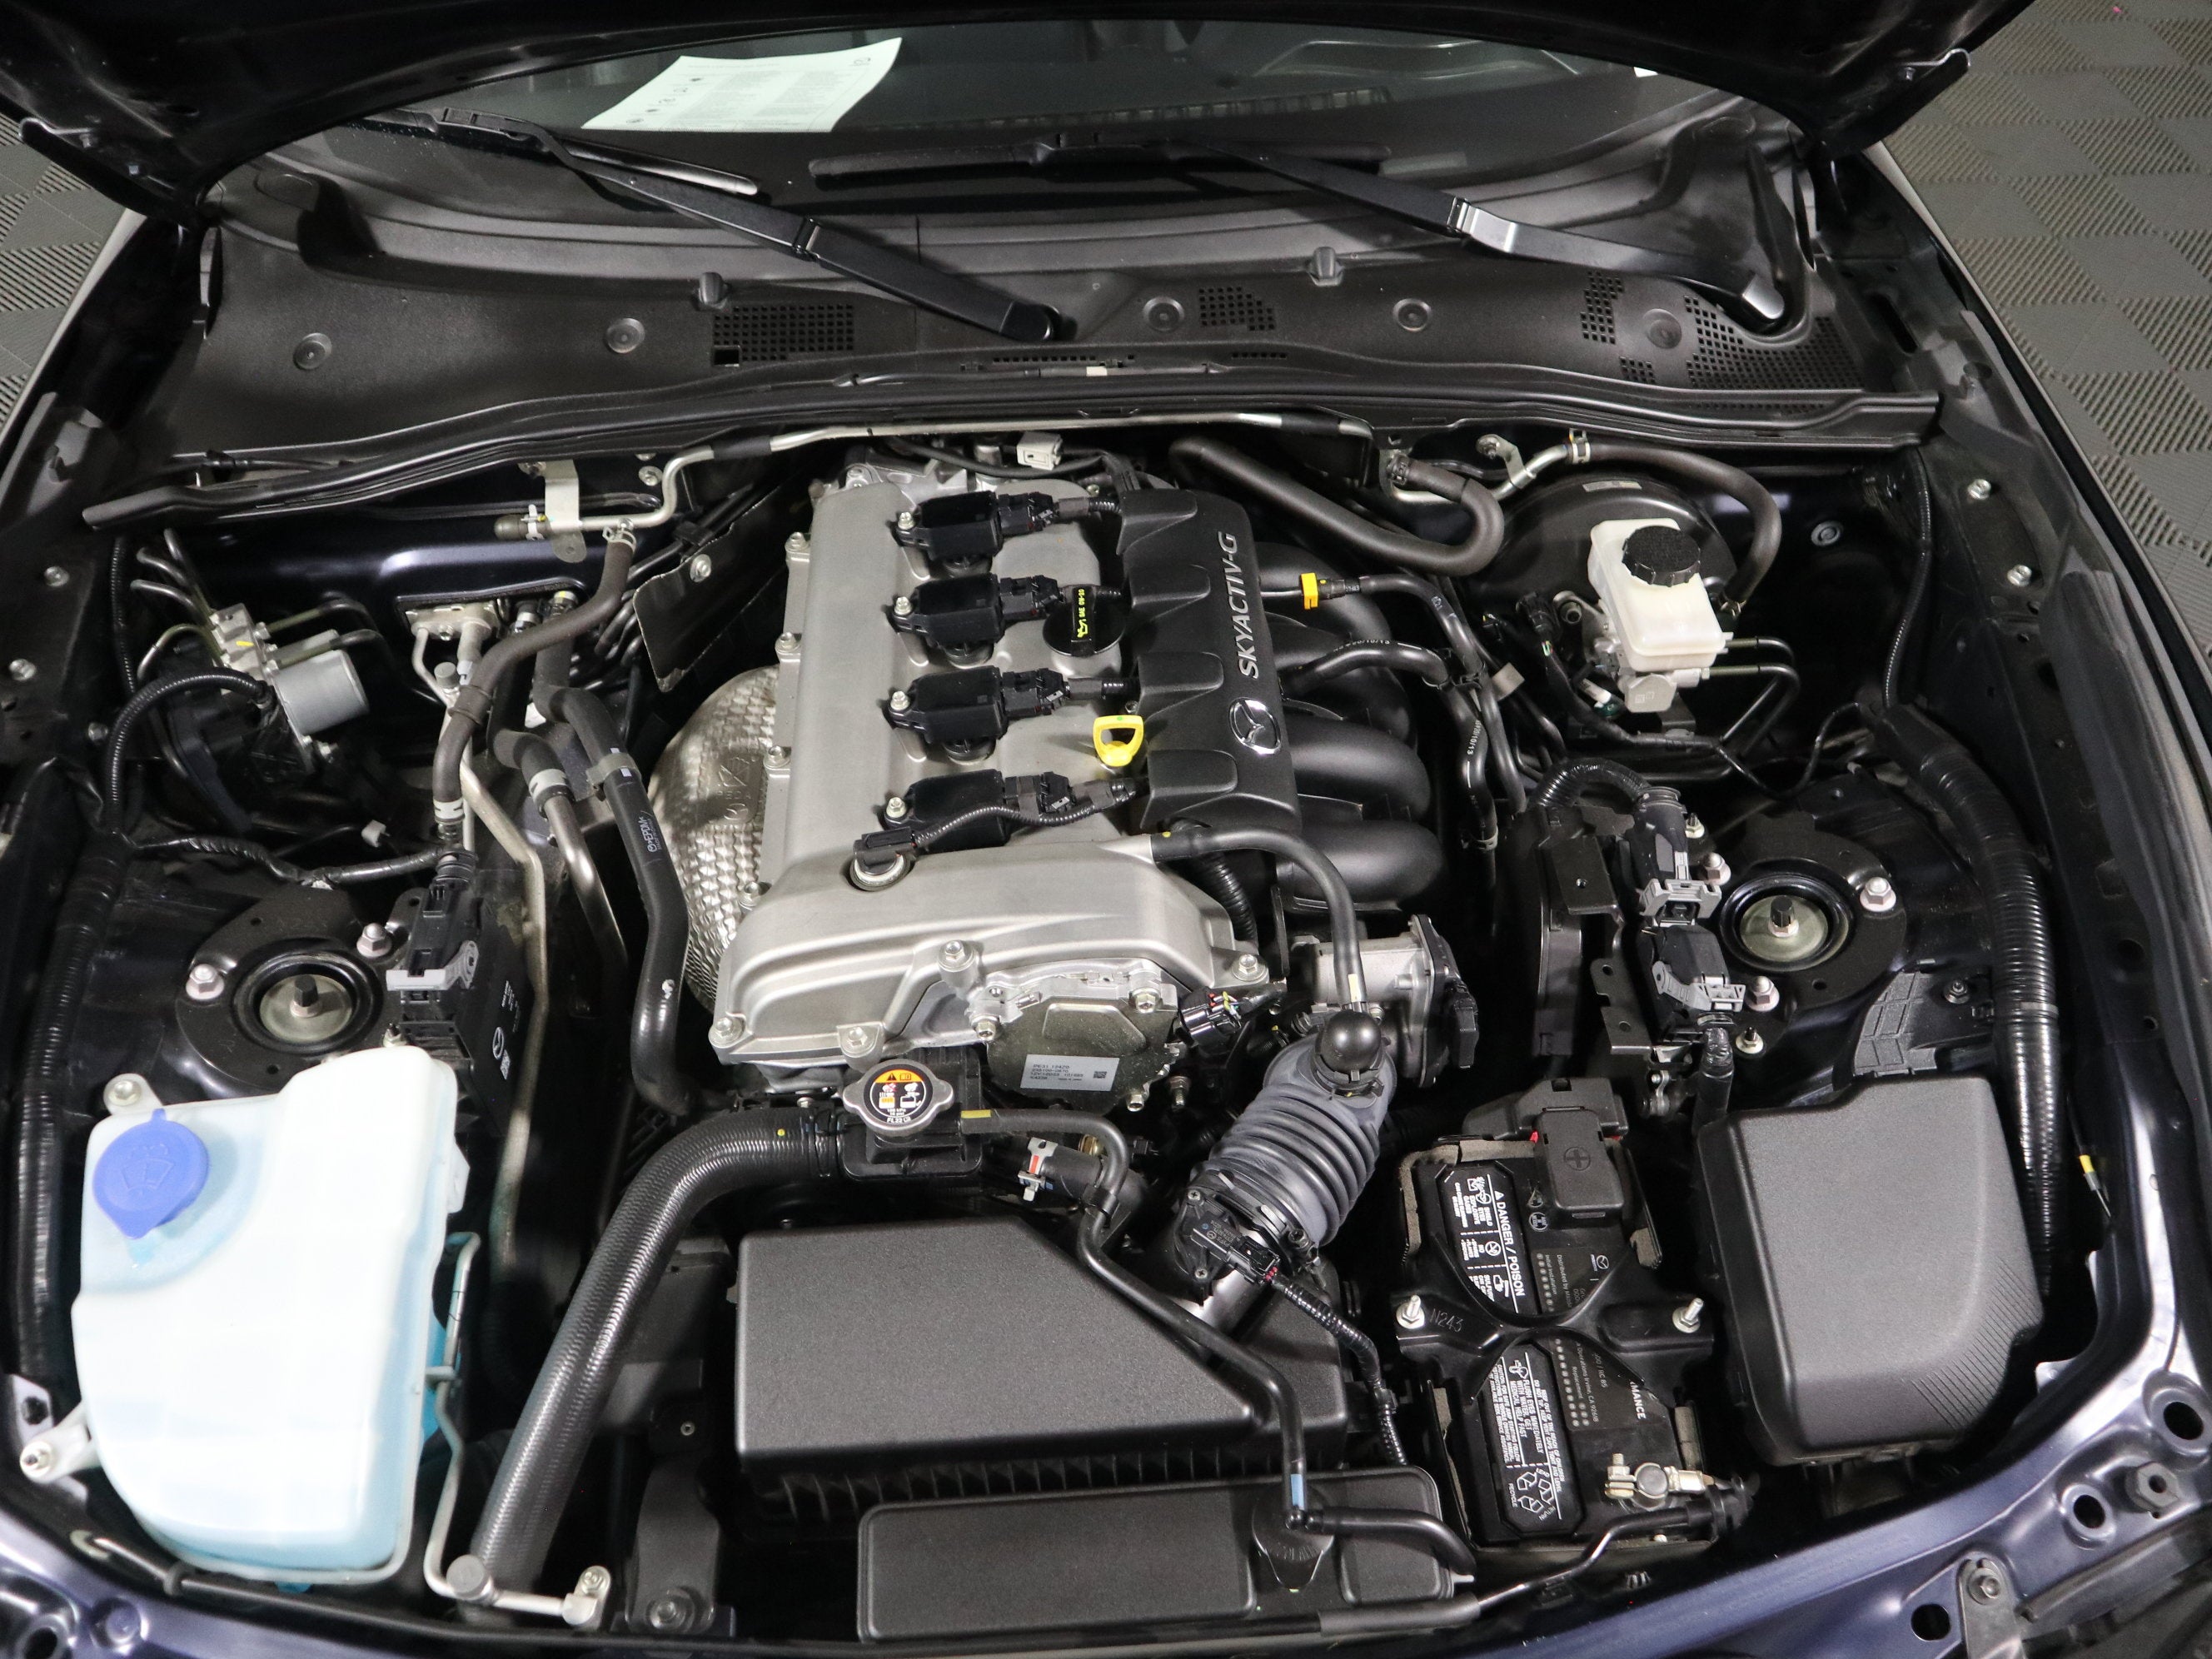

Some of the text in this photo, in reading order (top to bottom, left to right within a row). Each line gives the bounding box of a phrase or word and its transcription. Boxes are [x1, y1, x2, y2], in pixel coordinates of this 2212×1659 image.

[1218, 531, 1258, 679] SKYACTIV-G
[1469, 1194, 1481, 1225] EXPLOSIVE
[1483, 1206, 1493, 1226] SHIELD
[1496, 1201, 1514, 1246] DANGER
[1507, 1256, 1525, 1297] POISON
[1547, 1268, 1557, 1294] Installation
[1556, 1253, 1567, 1283] Distributed
[1430, 1308, 1464, 1333] N243
[1576, 1346, 1587, 1377] Operations
[1597, 1368, 1605, 1378] RC
[1583, 1377, 1592, 1394] Irvine,
[1599, 1378, 1607, 1387] 85
[1488, 1380, 1498, 1402] AVAILABLE
[1496, 1415, 1504, 1434] SERVICE
[1498, 1402, 1507, 1421] VEHICLE
[1510, 1380, 1527, 1437] MEDICAL HELP FAST
[1516, 1380, 1525, 1394] WITH
[1523, 1418, 1532, 1430] GET
[1587, 1395, 1595, 1403] CA
[1589, 1404, 1599, 1422] 92618
[1522, 1379, 1543, 1453] FLUSH EYES IMMEDIATELY
[1507, 1420, 1517, 1442] STARTING
[1512, 1442, 1521, 1462] FOLLOW
[1539, 1409, 1547, 1422] KEEP
[1553, 1477, 1562, 1492] LEVEL
[1542, 1402, 1551, 1412] OUT
[1555, 1457, 1565, 1482] CHILDREN
[1507, 1482, 1517, 1507] RECYCLE
[1538, 1505, 1556, 1521] RETURN
